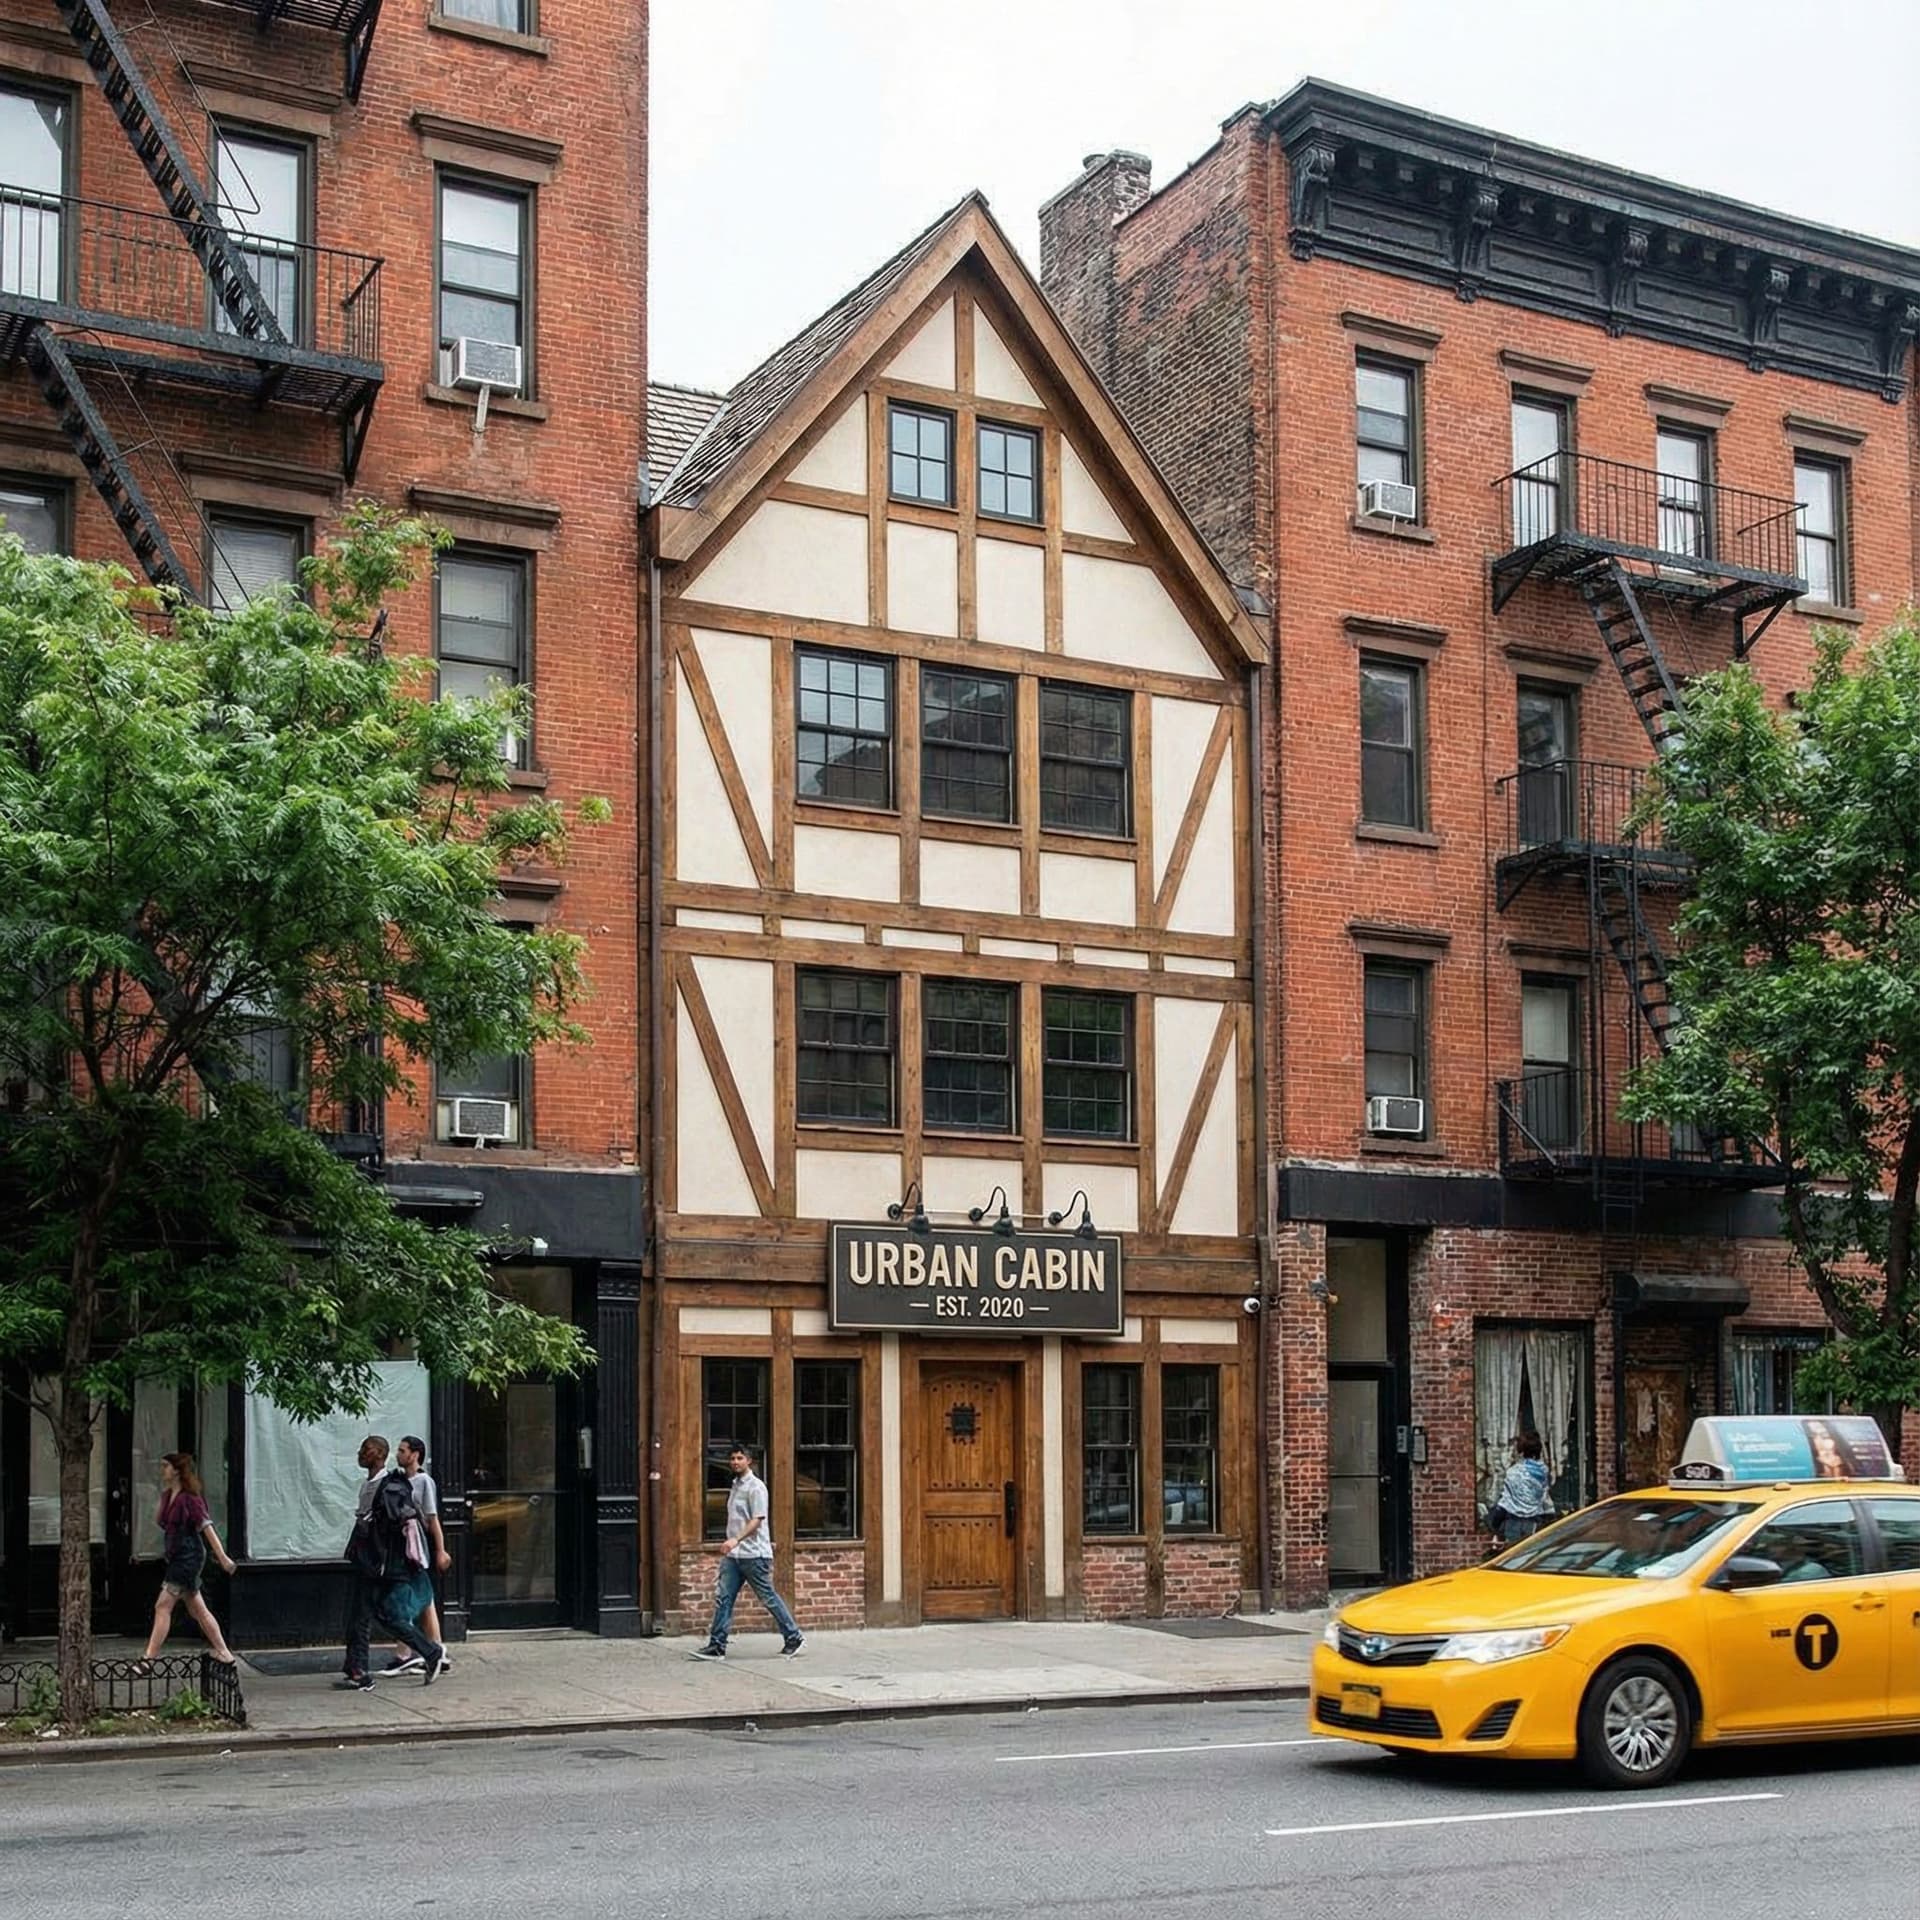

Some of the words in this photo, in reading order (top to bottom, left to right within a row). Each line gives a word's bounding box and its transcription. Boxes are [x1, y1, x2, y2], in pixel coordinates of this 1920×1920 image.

[850, 1240, 978, 1288] URBAN
[995, 1246, 1104, 1291] CABIN
[936, 1295, 971, 1317] EST.
[979, 1296, 1023, 1318] 2020
[1804, 1624, 1828, 1663] T
